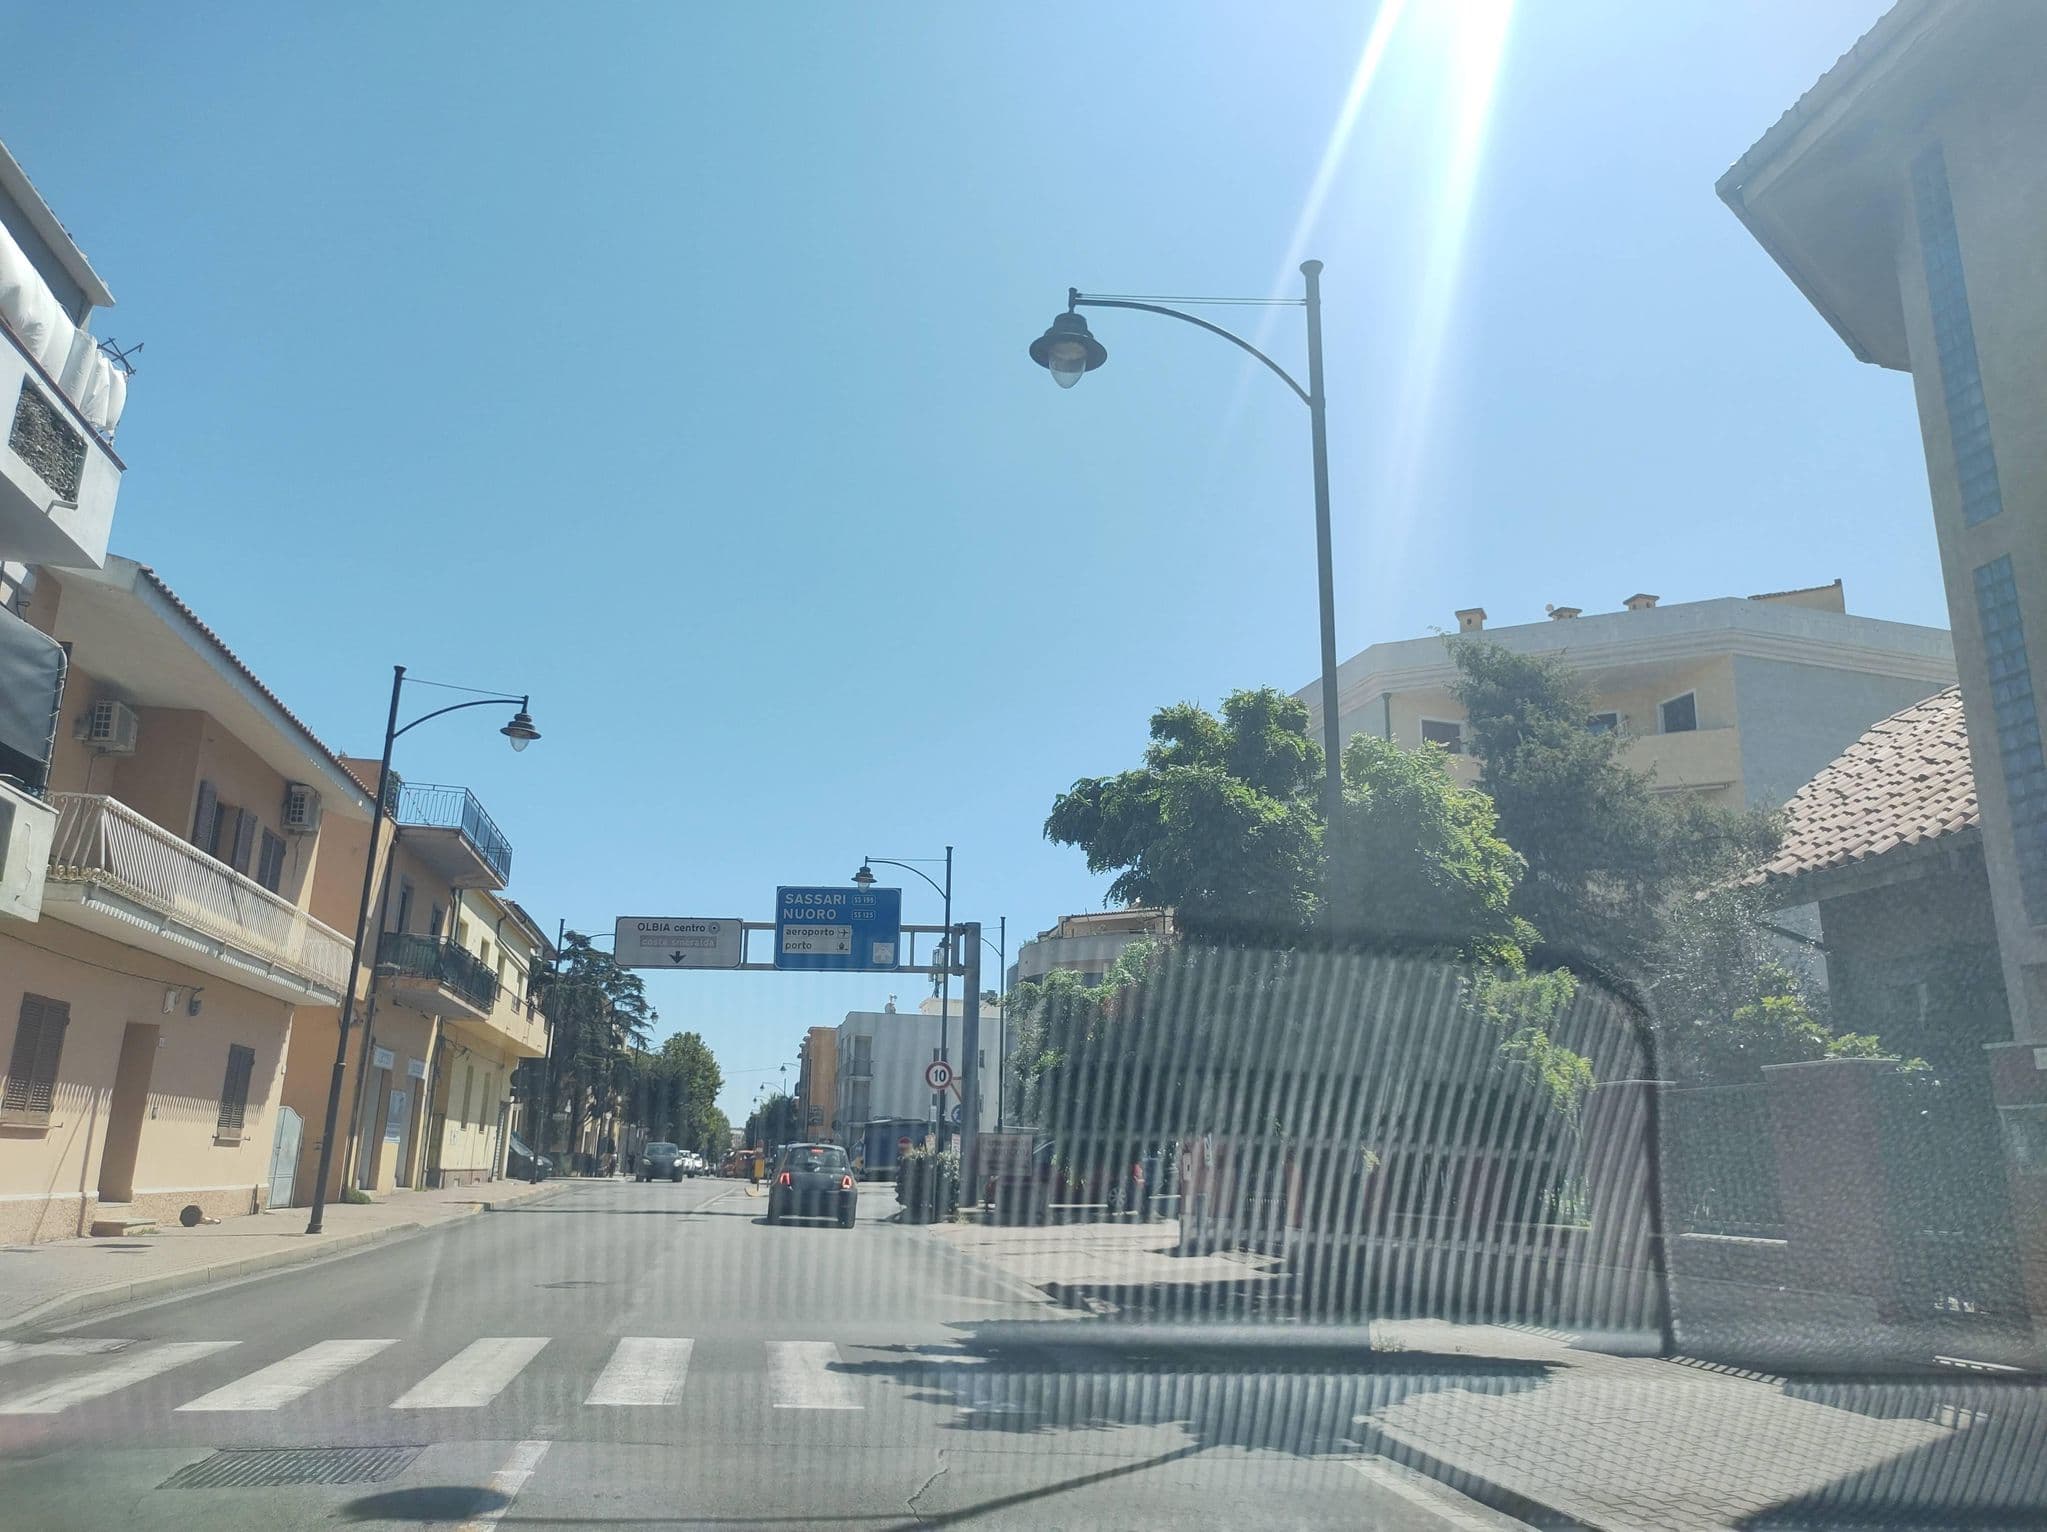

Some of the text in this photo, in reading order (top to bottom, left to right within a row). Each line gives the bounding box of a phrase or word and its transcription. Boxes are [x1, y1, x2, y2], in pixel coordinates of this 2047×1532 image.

[784, 893, 847, 905] SASSARI
[783, 908, 837, 920] NUORO
[637, 922, 706, 932] OLBIA centro
[785, 927, 835, 937] aeroporto
[785, 941, 812, 951] porto
[933, 1069, 947, 1083] 10
